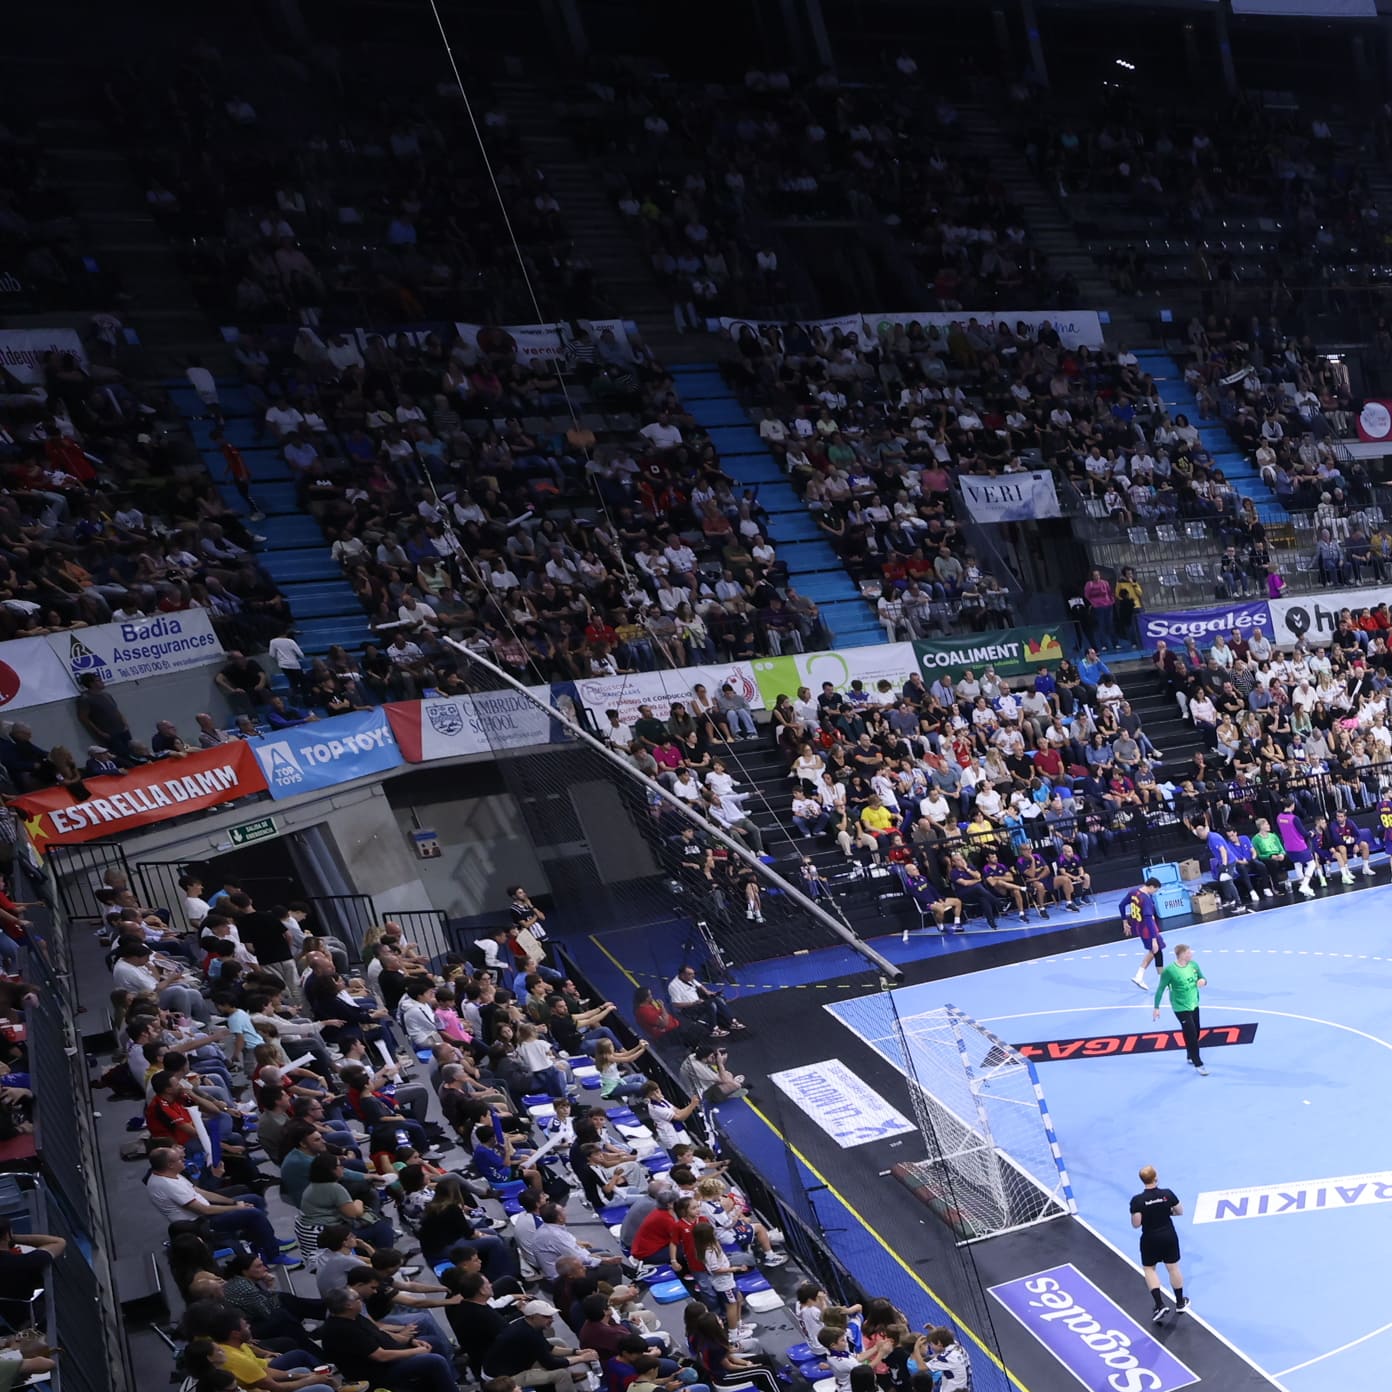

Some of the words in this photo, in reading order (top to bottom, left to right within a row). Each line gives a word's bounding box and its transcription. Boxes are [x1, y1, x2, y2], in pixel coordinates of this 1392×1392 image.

[120, 617, 183, 643] Badia
[1147, 611, 1267, 638] Sagalés
[113, 631, 215, 664] Assegurances
[923, 643, 1019, 669] COALIMENT
[470, 714, 519, 734] SCHOOL
[300, 740, 341, 766] TOP
[275, 767, 294, 776] TOP
[276, 774, 303, 787] TOYS
[48, 779, 175, 836] ESTRELLA
[170, 764, 240, 803] DAMM
[1164, 898, 1185, 910] PRIME
